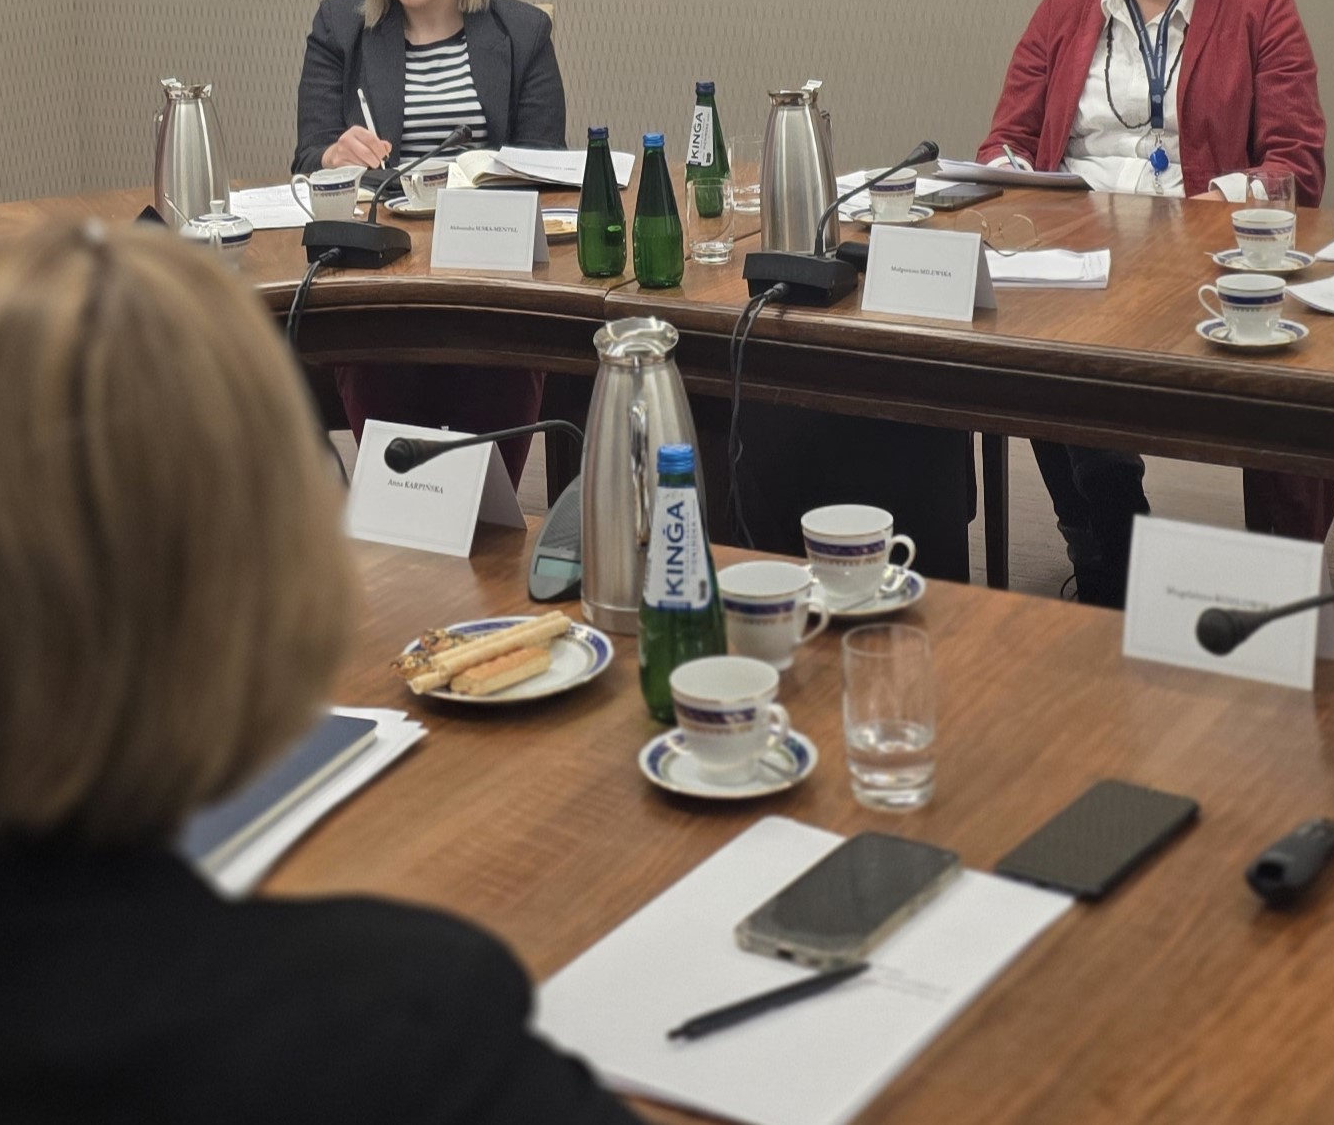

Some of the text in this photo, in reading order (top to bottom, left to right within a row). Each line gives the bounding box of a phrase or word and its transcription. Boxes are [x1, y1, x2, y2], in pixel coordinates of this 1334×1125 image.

[691, 112, 703, 160] KINGA
[387, 478, 404, 487] Anna
[665, 500, 685, 596] KINGA
